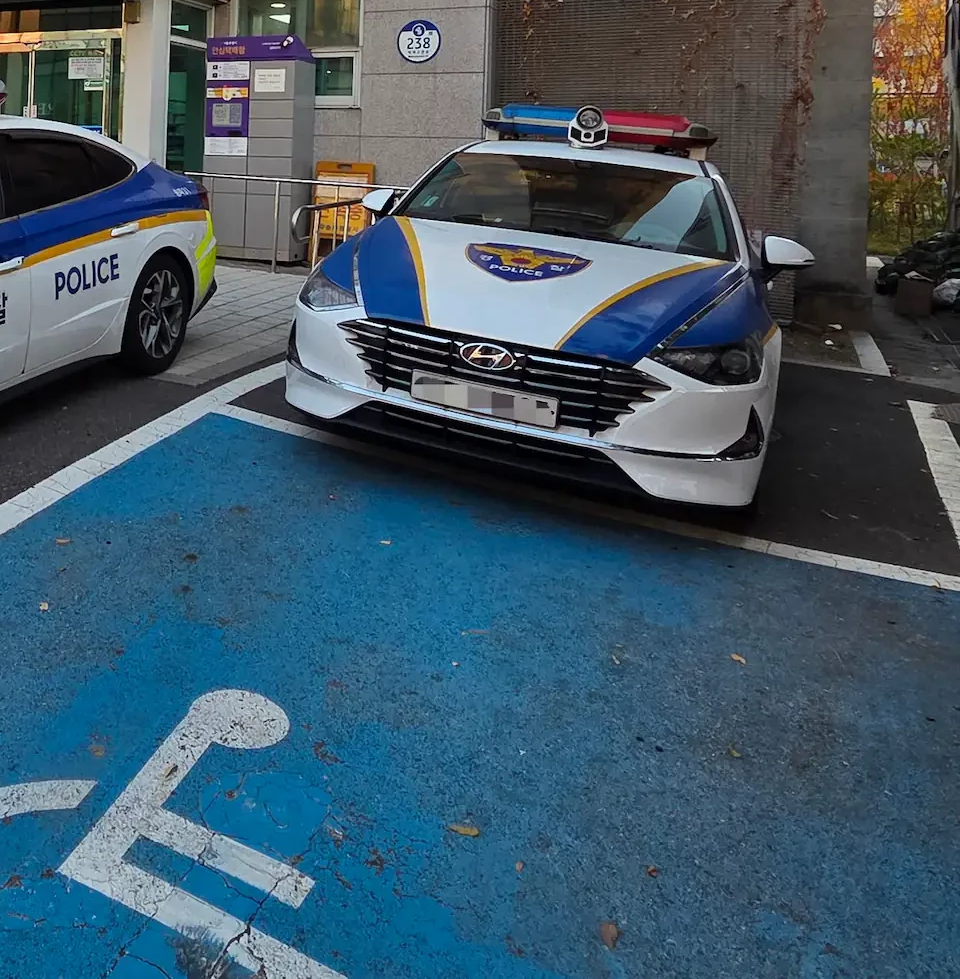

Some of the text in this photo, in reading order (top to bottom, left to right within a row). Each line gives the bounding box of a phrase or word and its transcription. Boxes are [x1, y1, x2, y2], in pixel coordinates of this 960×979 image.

[406, 36, 431, 50] 238
[54, 253, 120, 301] POLICE
[489, 263, 544, 277] POLICE
